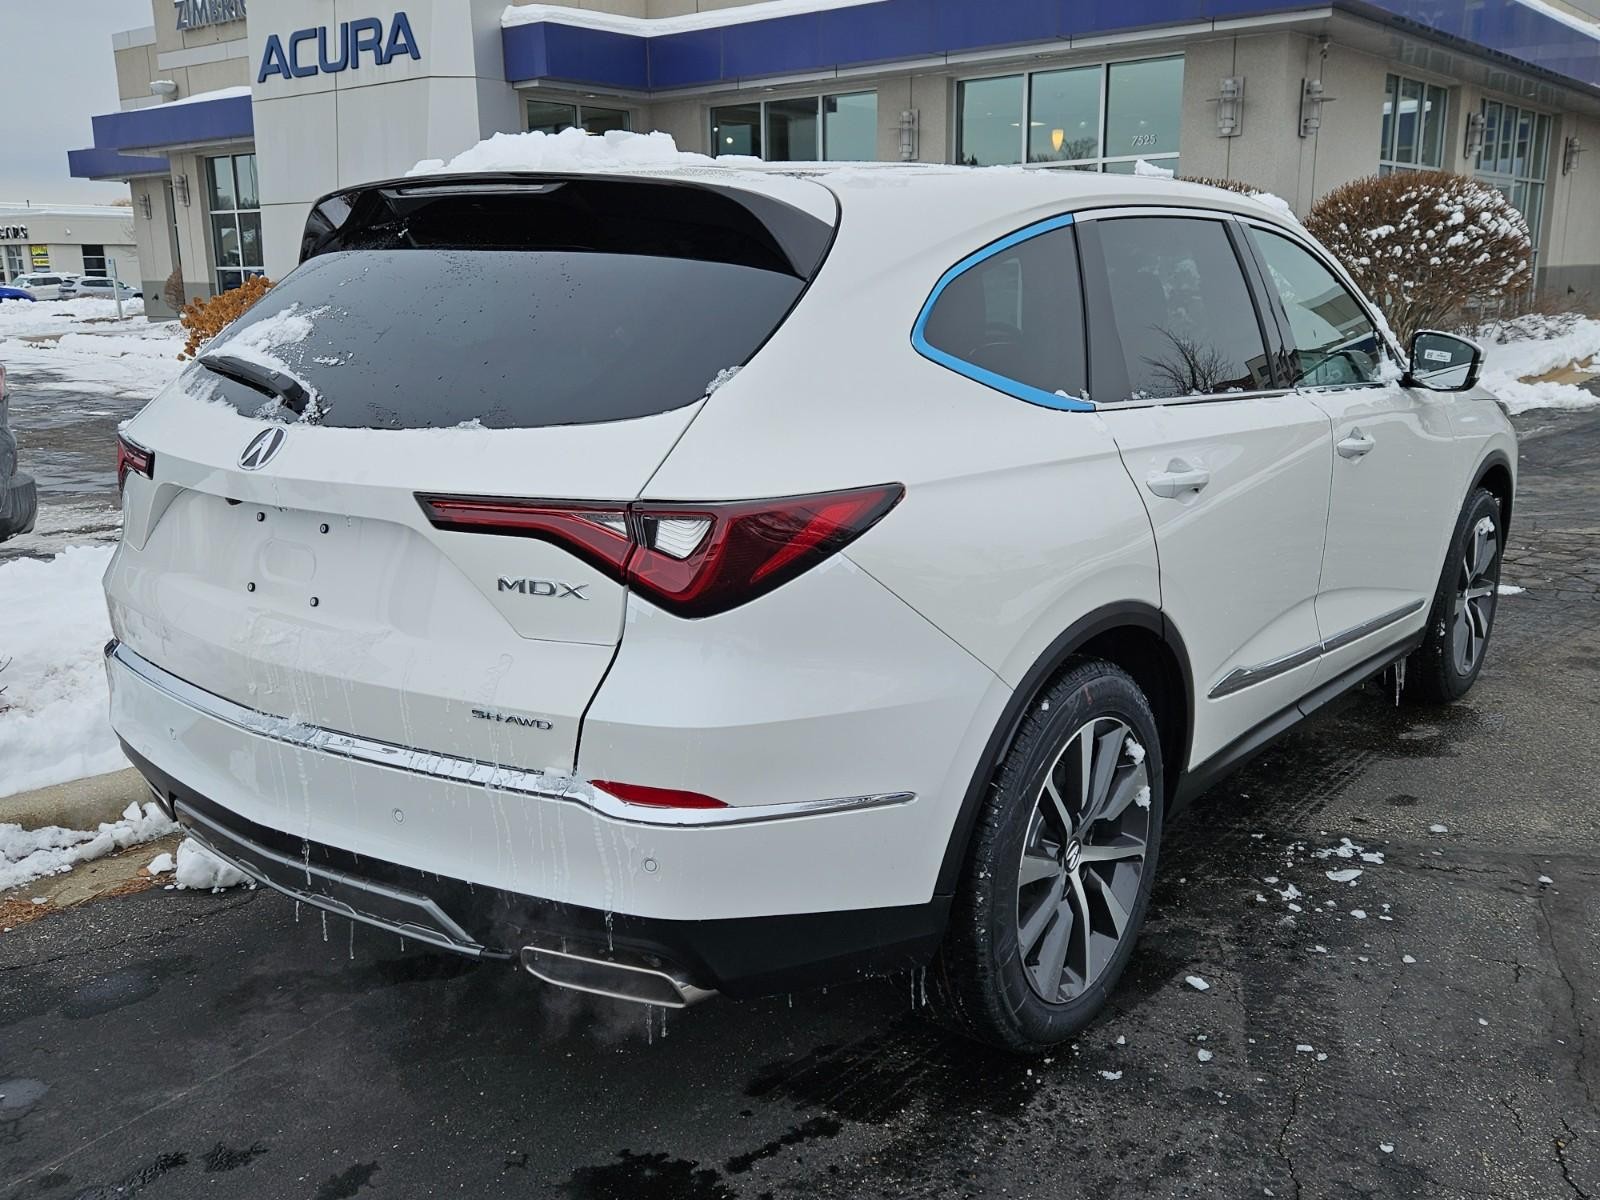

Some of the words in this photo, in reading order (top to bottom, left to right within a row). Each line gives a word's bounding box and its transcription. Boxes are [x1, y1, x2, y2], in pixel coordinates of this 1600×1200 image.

[257, 11, 421, 83] ACURA
[1131, 134, 1157, 146] 7525
[497, 576, 590, 601] MDX
